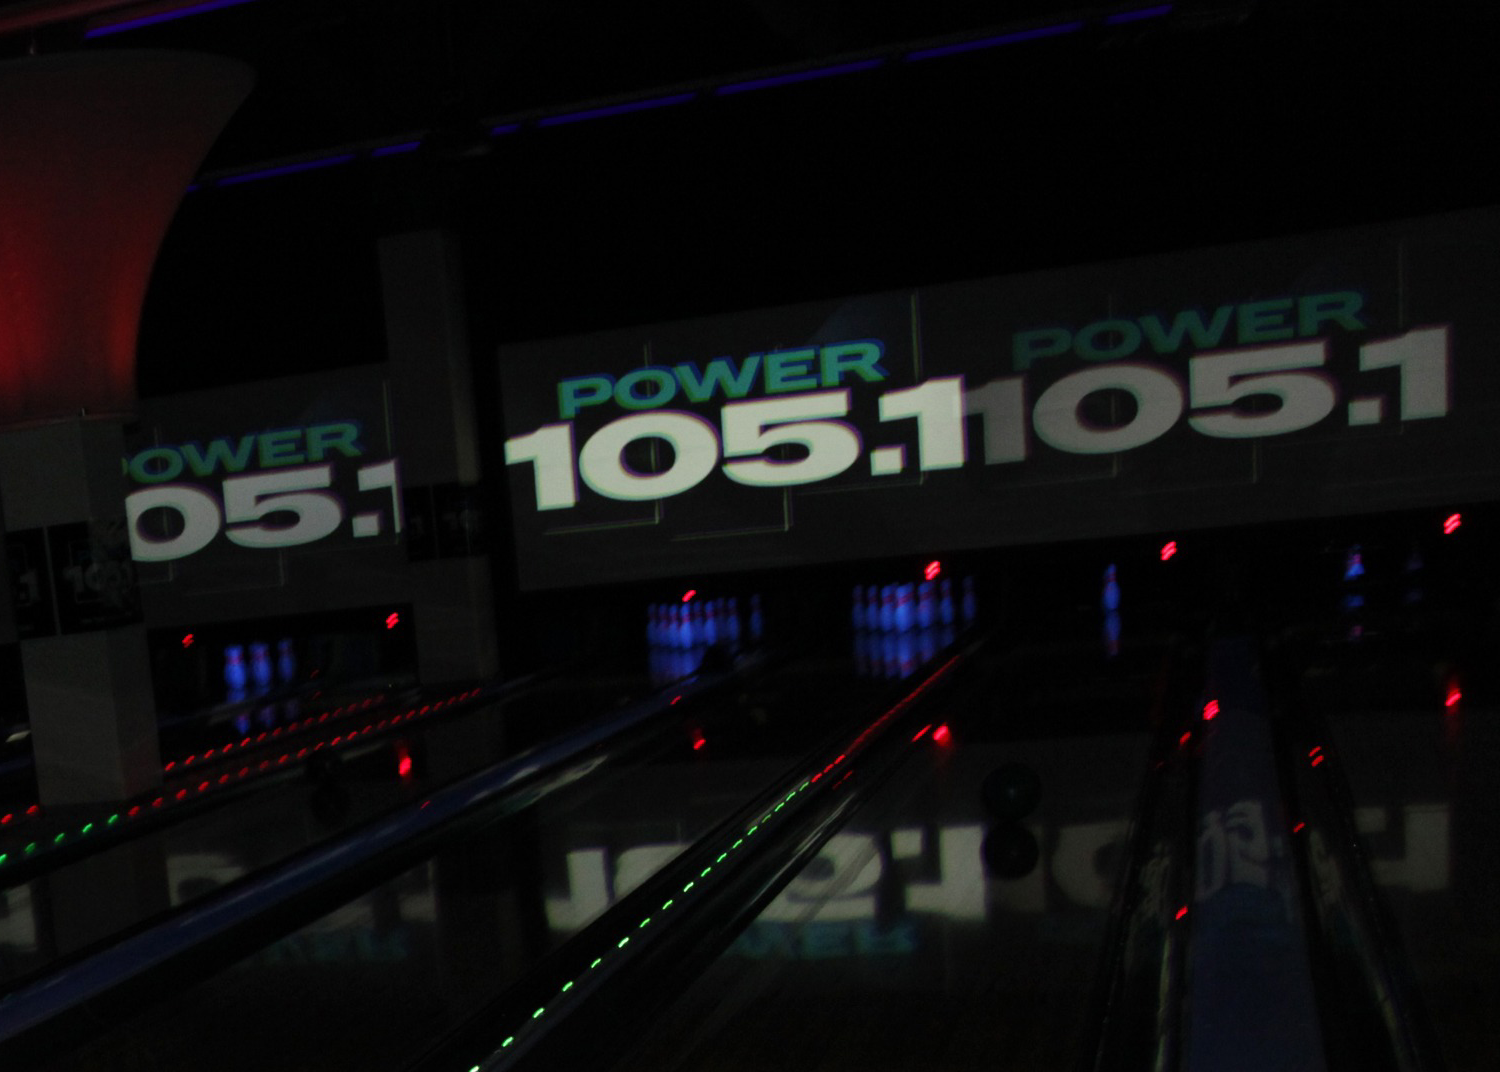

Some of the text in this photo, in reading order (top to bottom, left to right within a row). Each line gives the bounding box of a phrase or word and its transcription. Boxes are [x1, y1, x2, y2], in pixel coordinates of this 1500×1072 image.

[1011, 290, 1368, 371] POWER
[558, 338, 888, 419] POWER
[965, 323, 1452, 465] 105.1
[122, 420, 364, 484] OWER
[504, 374, 967, 512] 105.1
[125, 457, 402, 562] 05.1
